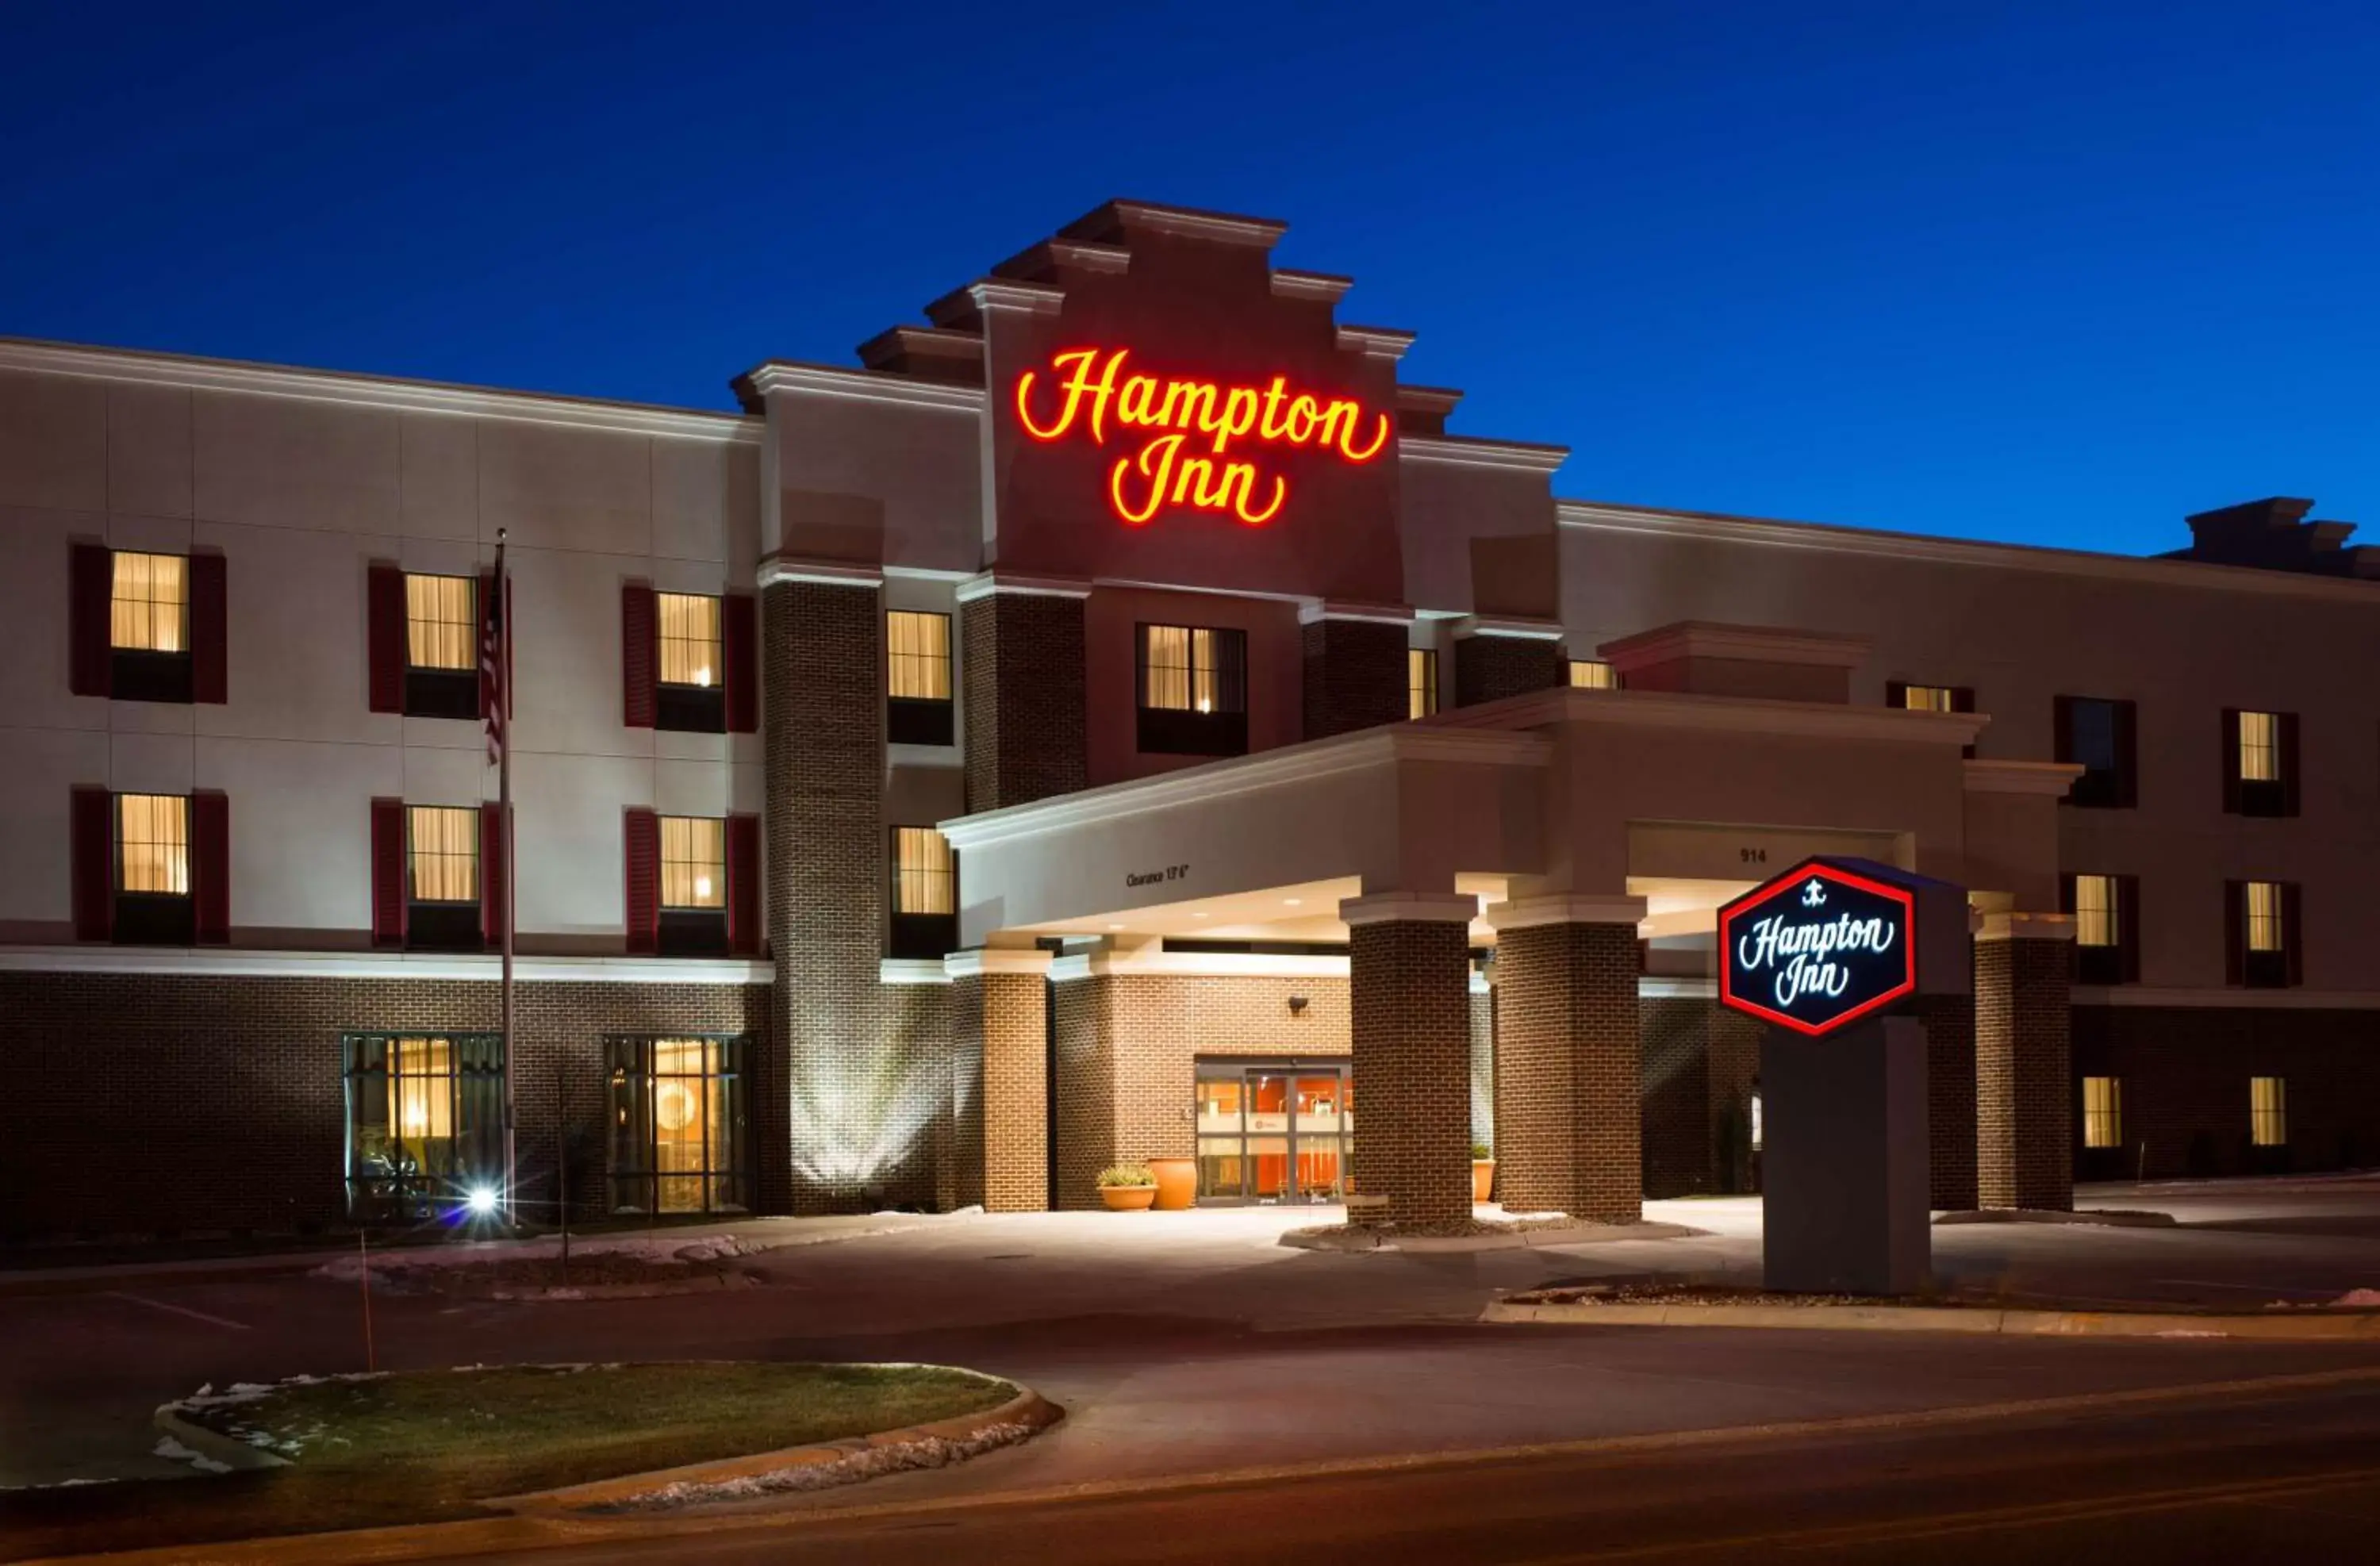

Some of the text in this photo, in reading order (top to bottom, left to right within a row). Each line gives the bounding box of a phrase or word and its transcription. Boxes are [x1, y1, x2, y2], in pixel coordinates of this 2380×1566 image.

[1018, 349, 1388, 460] Hampton
[1112, 434, 1284, 522] Inn
[1741, 848, 1766, 863] 914
[1739, 913, 1894, 969] Hampton
[1775, 954, 1848, 1006] Inn
